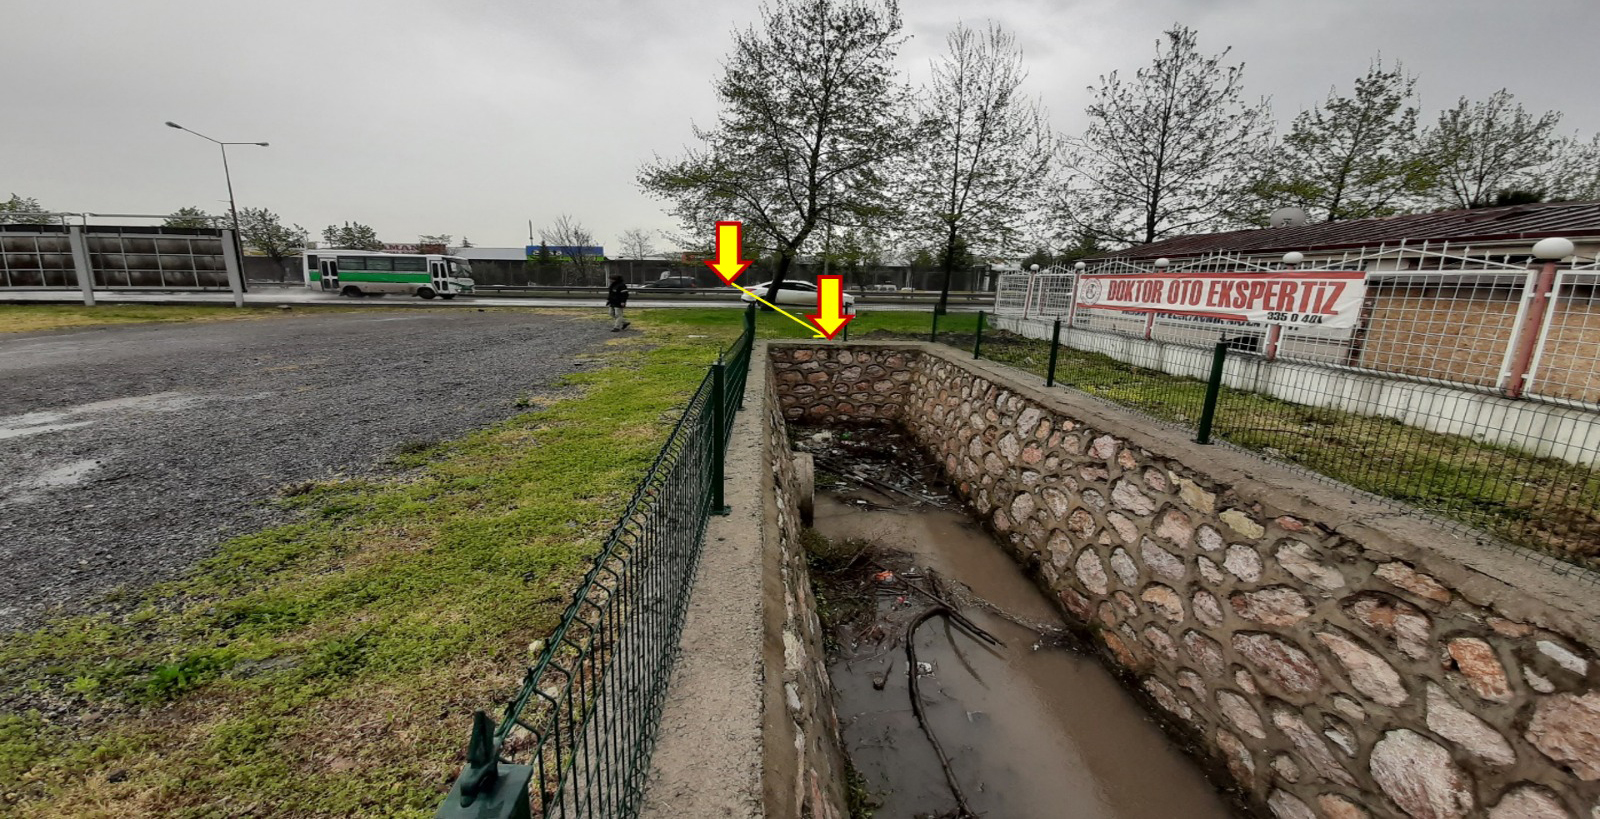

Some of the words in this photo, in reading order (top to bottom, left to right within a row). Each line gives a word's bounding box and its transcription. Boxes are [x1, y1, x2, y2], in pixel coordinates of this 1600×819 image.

[1107, 280, 1164, 303] DOKTOR
[1167, 280, 1203, 306] OTO
[1267, 311, 1288, 321] 335
